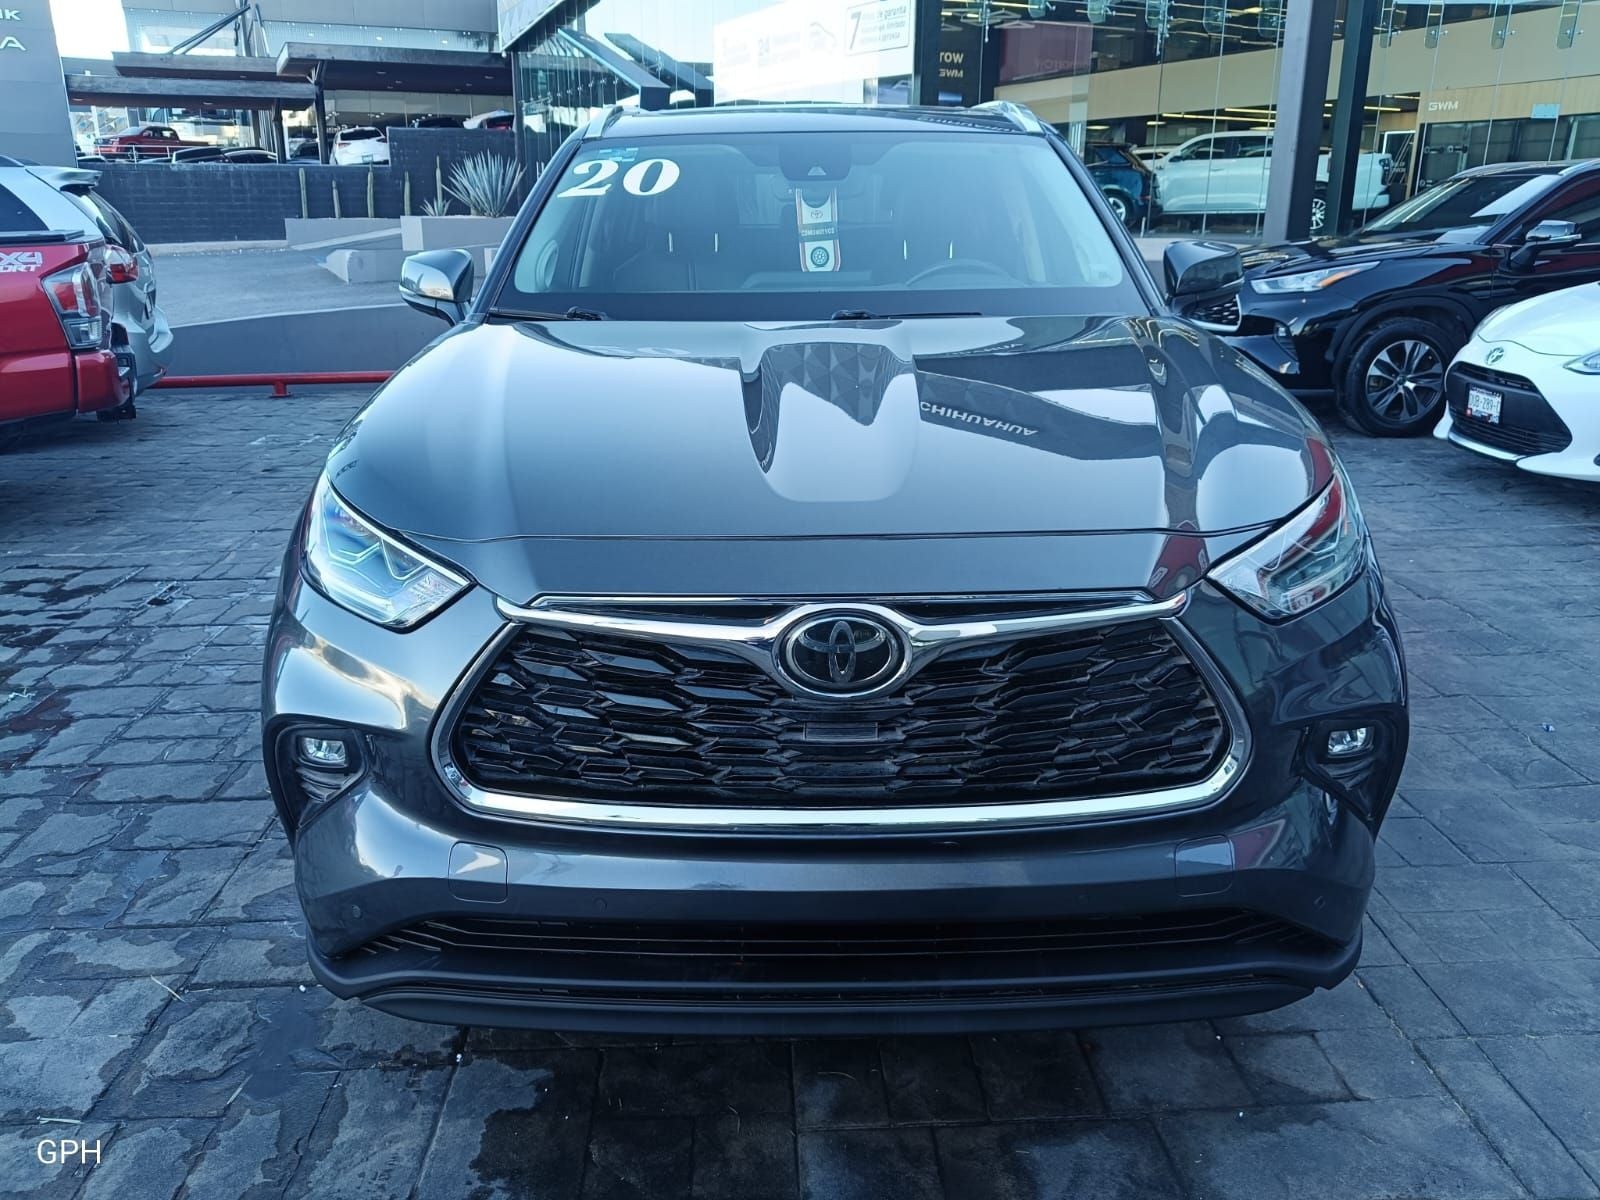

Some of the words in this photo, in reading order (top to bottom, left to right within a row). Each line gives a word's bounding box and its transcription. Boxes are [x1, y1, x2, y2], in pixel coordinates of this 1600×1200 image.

[850, 10, 862, 50] 7
[1428, 101, 1459, 112] GWM
[557, 158, 680, 198] 20
